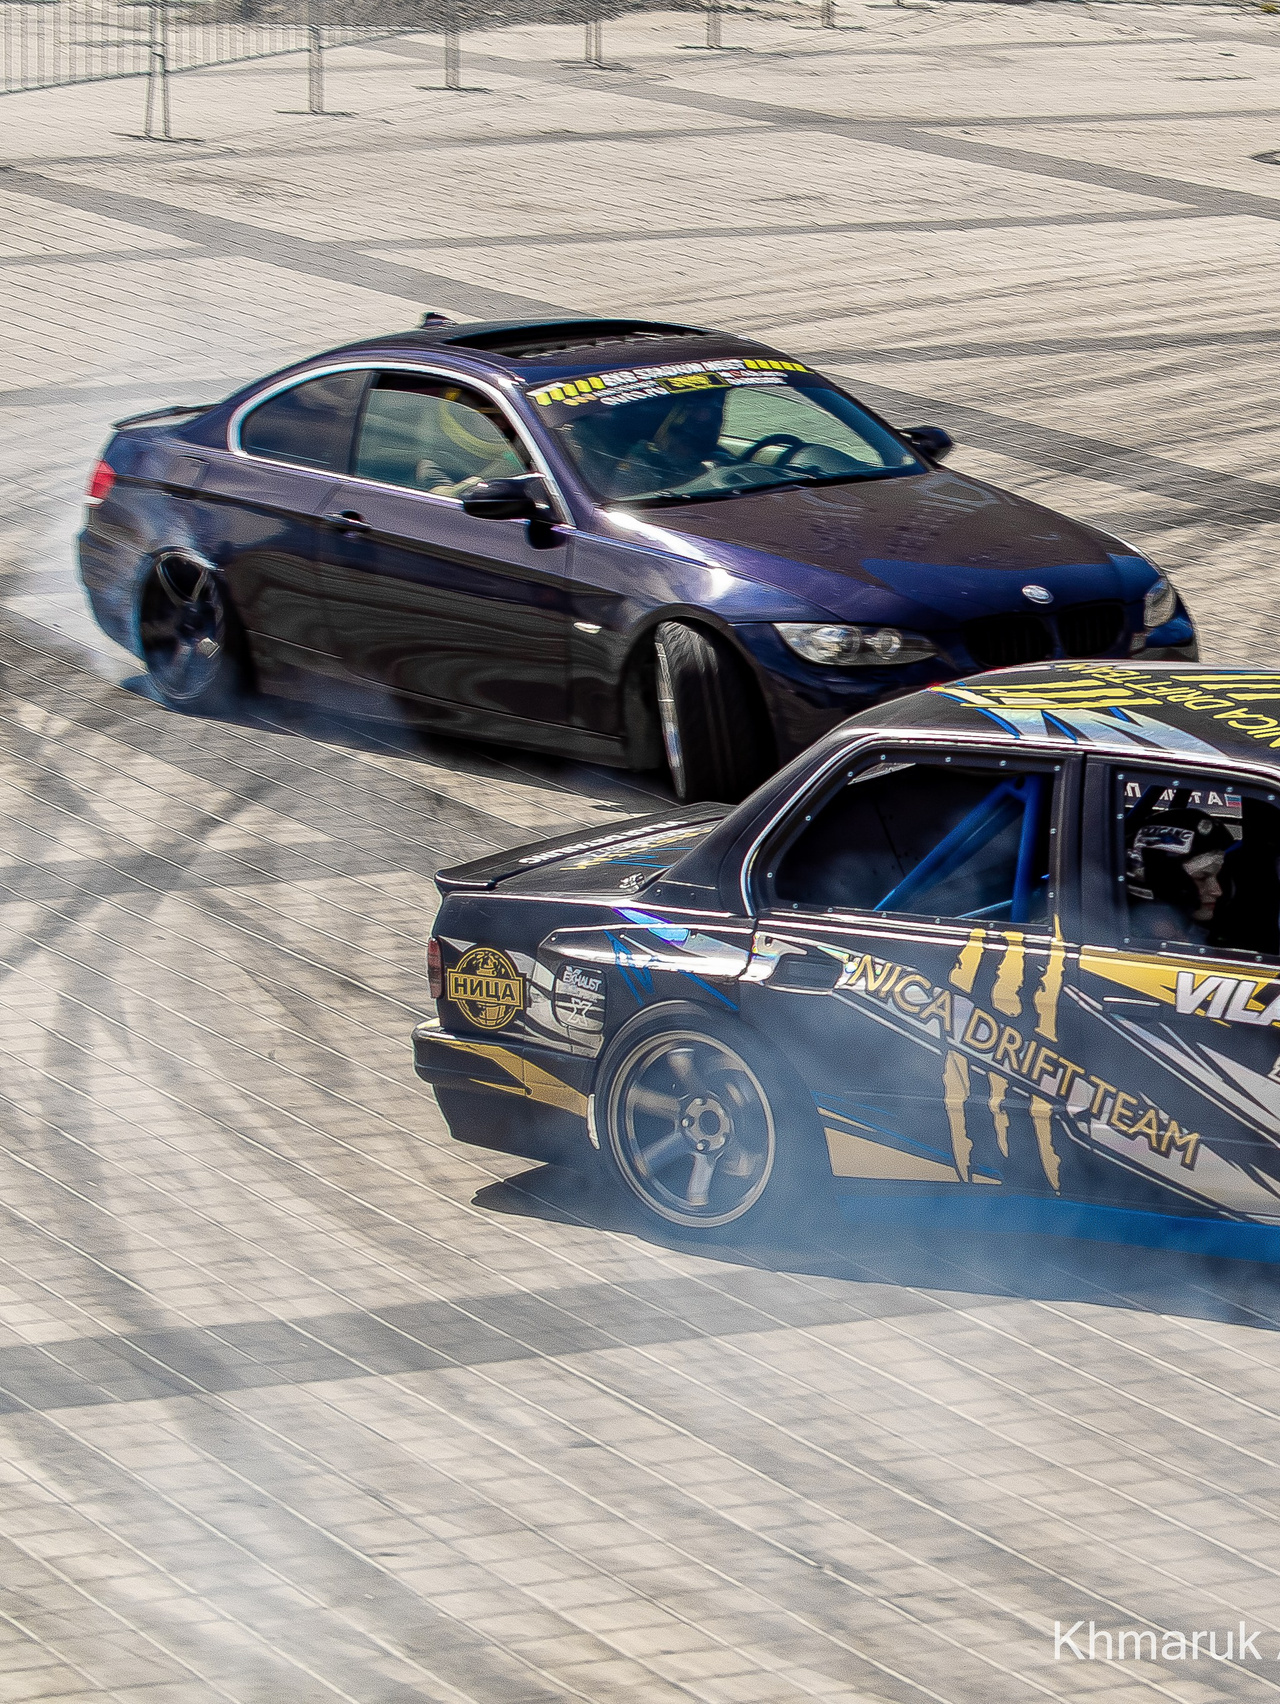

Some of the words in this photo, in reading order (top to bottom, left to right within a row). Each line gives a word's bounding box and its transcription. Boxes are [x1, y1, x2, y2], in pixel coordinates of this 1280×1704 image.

[1123, 680, 1236, 711] DRIFT
[453, 977, 516, 1002] НИЦА
[562, 966, 603, 992] EXHAUST
[850, 953, 952, 1032] NICA
[964, 1010, 1085, 1097] DRIFT
[1088, 1074, 1202, 1166] TEAM
